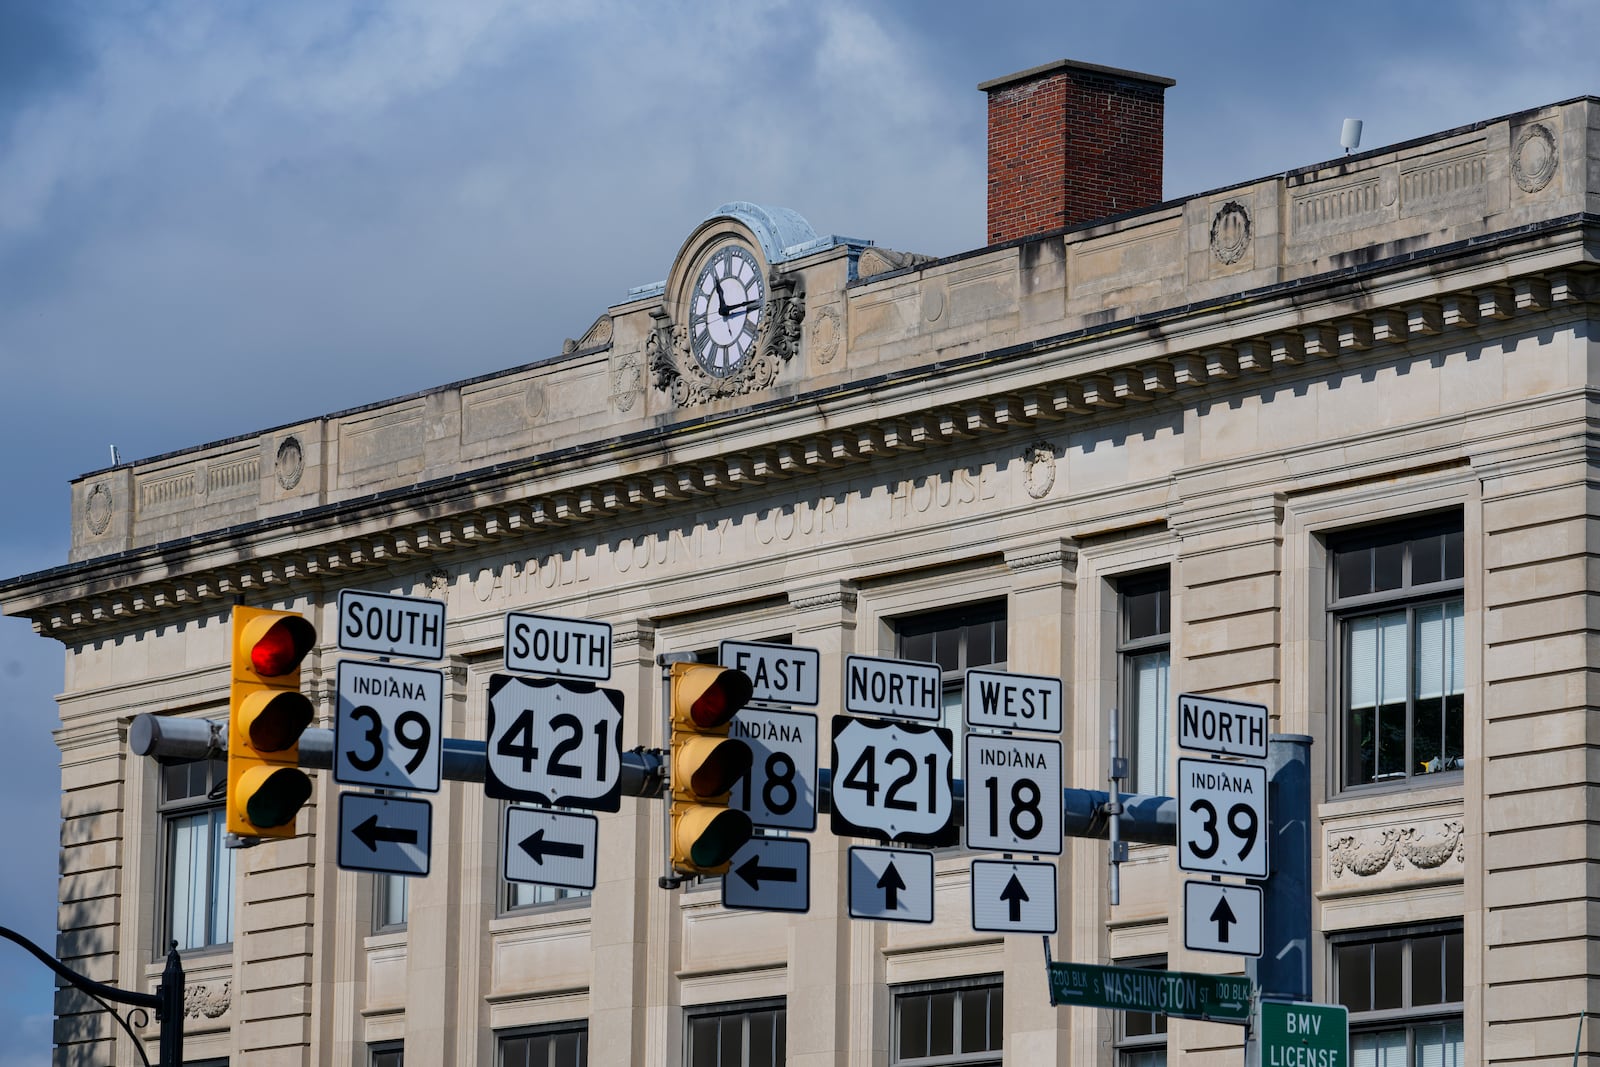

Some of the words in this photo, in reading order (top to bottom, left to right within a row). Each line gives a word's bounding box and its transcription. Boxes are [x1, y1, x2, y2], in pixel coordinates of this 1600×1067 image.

[473, 549, 591, 602] CARROLL
[613, 518, 732, 573] COUNTY
[754, 490, 860, 545] COURT
[889, 463, 996, 519] HOUSE
[346, 602, 438, 647] SOUTH
[513, 623, 605, 667] SOUTH
[354, 676, 426, 701] INDIANA
[736, 652, 806, 692] EAST
[851, 666, 936, 709] NORTH
[980, 681, 1052, 720] WEST
[346, 705, 431, 775] 39
[497, 709, 608, 782] 421
[735, 721, 802, 743] INDIANA
[1183, 704, 1263, 747] NORTH
[842, 745, 937, 814] 421
[981, 749, 1047, 770] INDIANA
[742, 751, 797, 815] 18
[1192, 772, 1254, 794] INDIANA
[985, 776, 1043, 840] 18
[1188, 799, 1258, 862] 39
[1052, 970, 1070, 987] 200
[1072, 971, 1088, 988] BLK
[1093, 979, 1100, 994] S
[1102, 972, 1196, 1010] WASHINGTON
[1200, 987, 1209, 1003] ST
[1215, 982, 1230, 999] 100
[1232, 984, 1249, 1000] BLK
[1287, 1012, 1322, 1036] BMV
[1271, 1045, 1338, 1067] LICENSE
